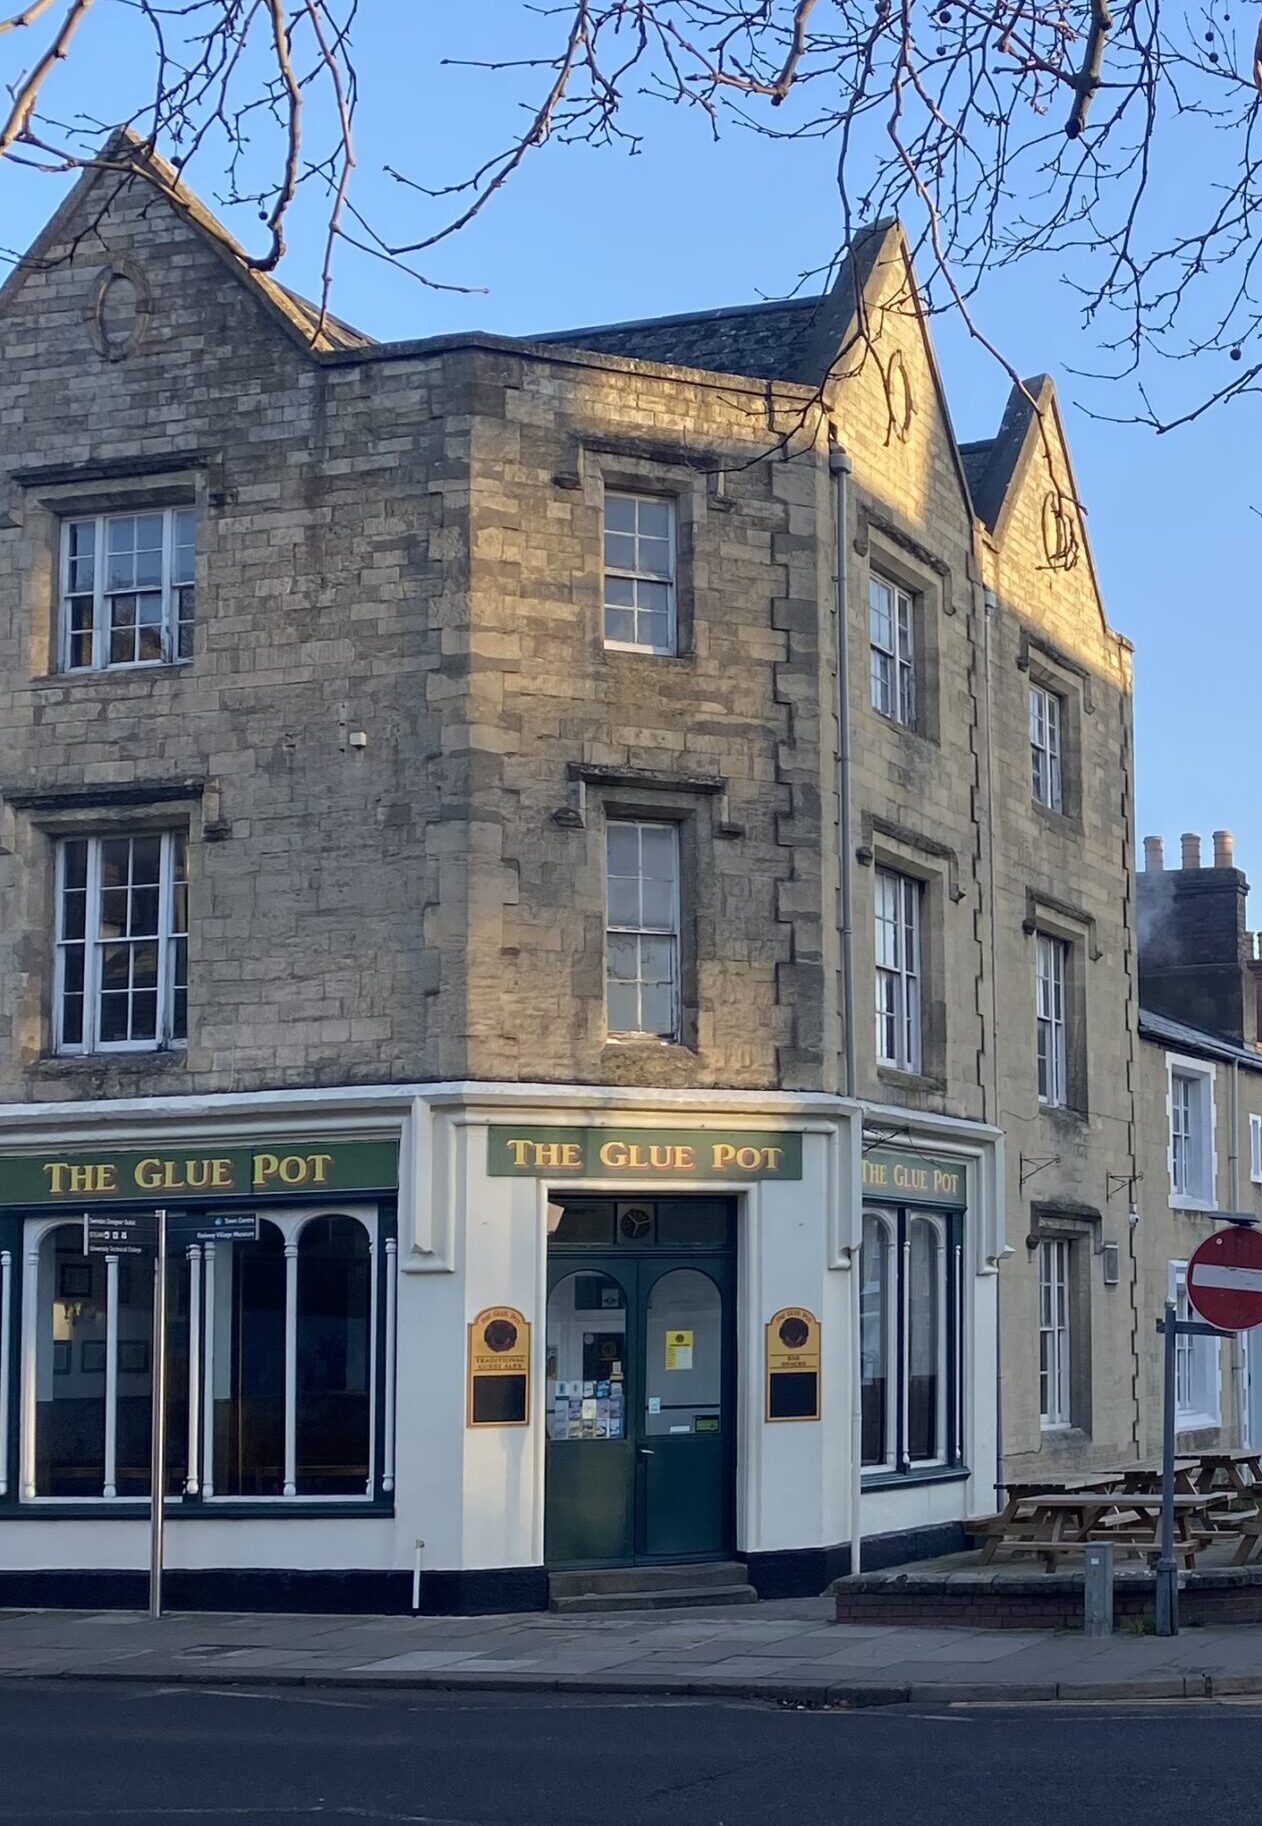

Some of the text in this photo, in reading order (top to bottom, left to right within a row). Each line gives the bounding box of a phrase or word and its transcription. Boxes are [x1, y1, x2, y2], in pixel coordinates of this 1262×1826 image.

[507, 1139, 785, 1171] THE GLUE POT
[43, 1153, 335, 1194] THE GLUE POT
[861, 1159, 960, 1193] THE GLUE POT
